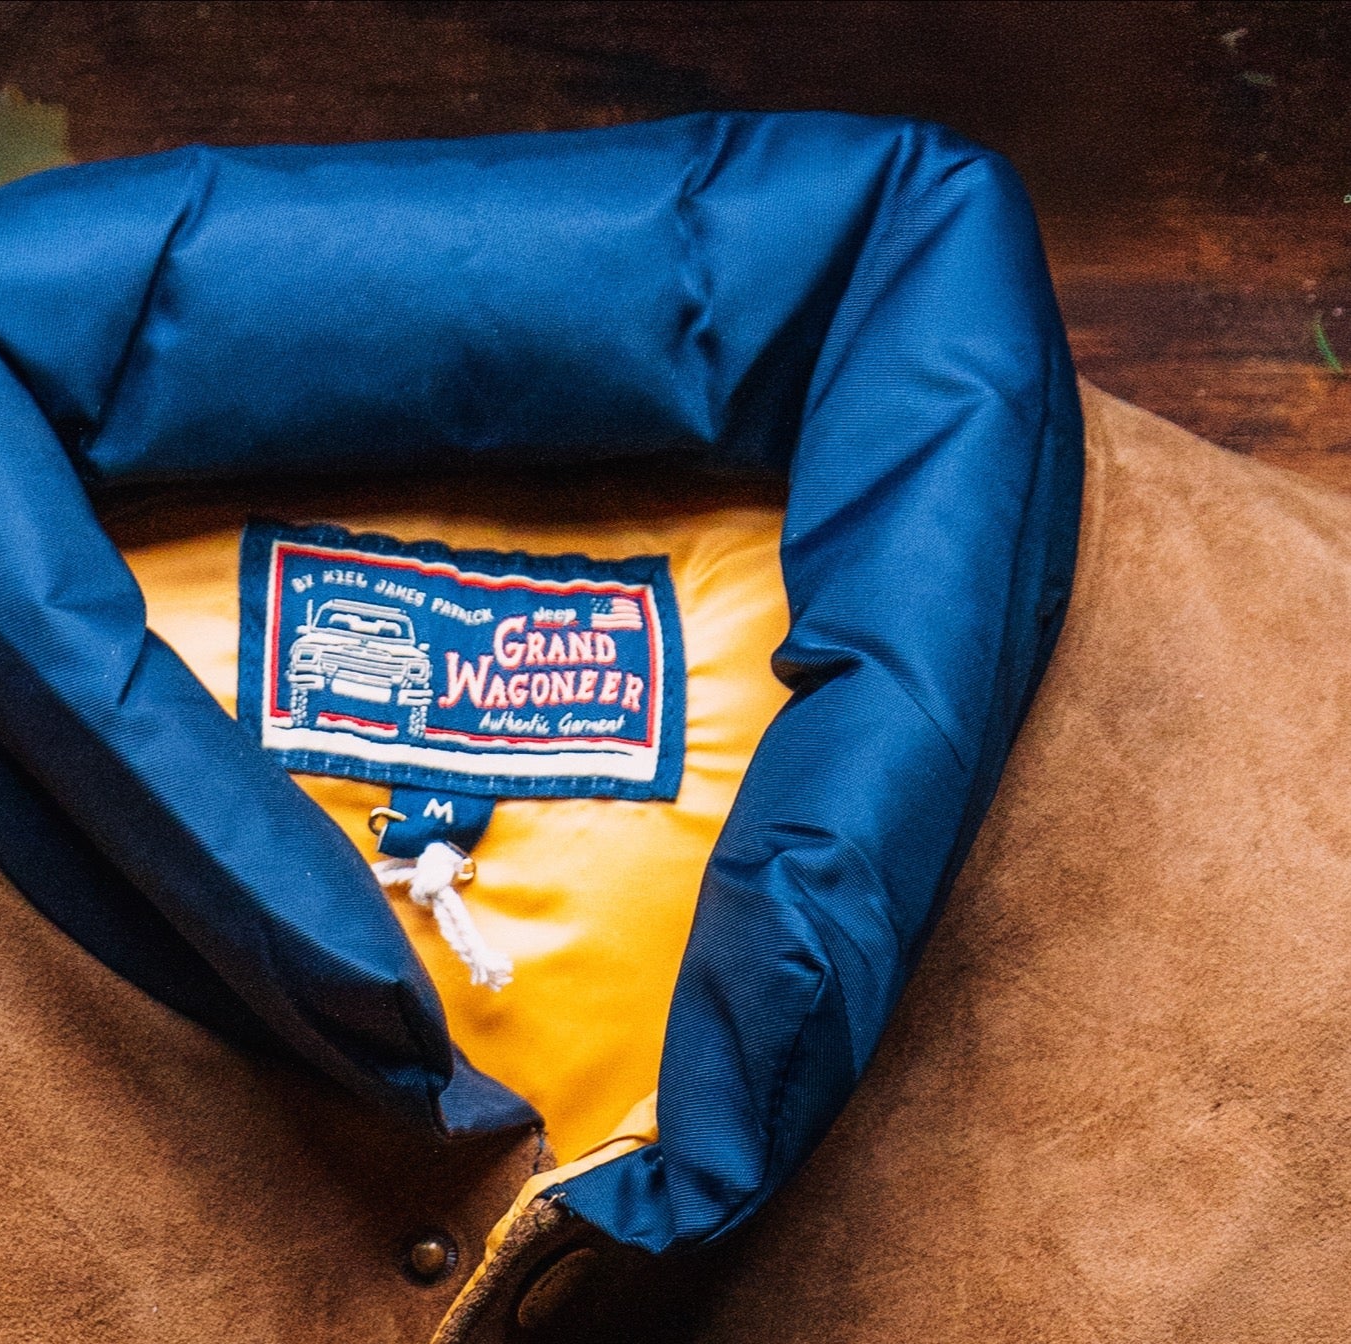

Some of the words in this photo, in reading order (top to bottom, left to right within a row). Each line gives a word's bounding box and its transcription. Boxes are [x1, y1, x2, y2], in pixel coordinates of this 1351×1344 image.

[291, 574, 314, 593] BY
[374, 579, 426, 607] JAMES
[430, 597, 494, 625] PATRICK
[533, 607, 577, 625] Jeep
[493, 615, 616, 669] GRAND
[438, 651, 644, 713] WAGONEER
[479, 711, 550, 733] Authentic
[558, 712, 626, 735] Garment
[423, 798, 453, 823] M
